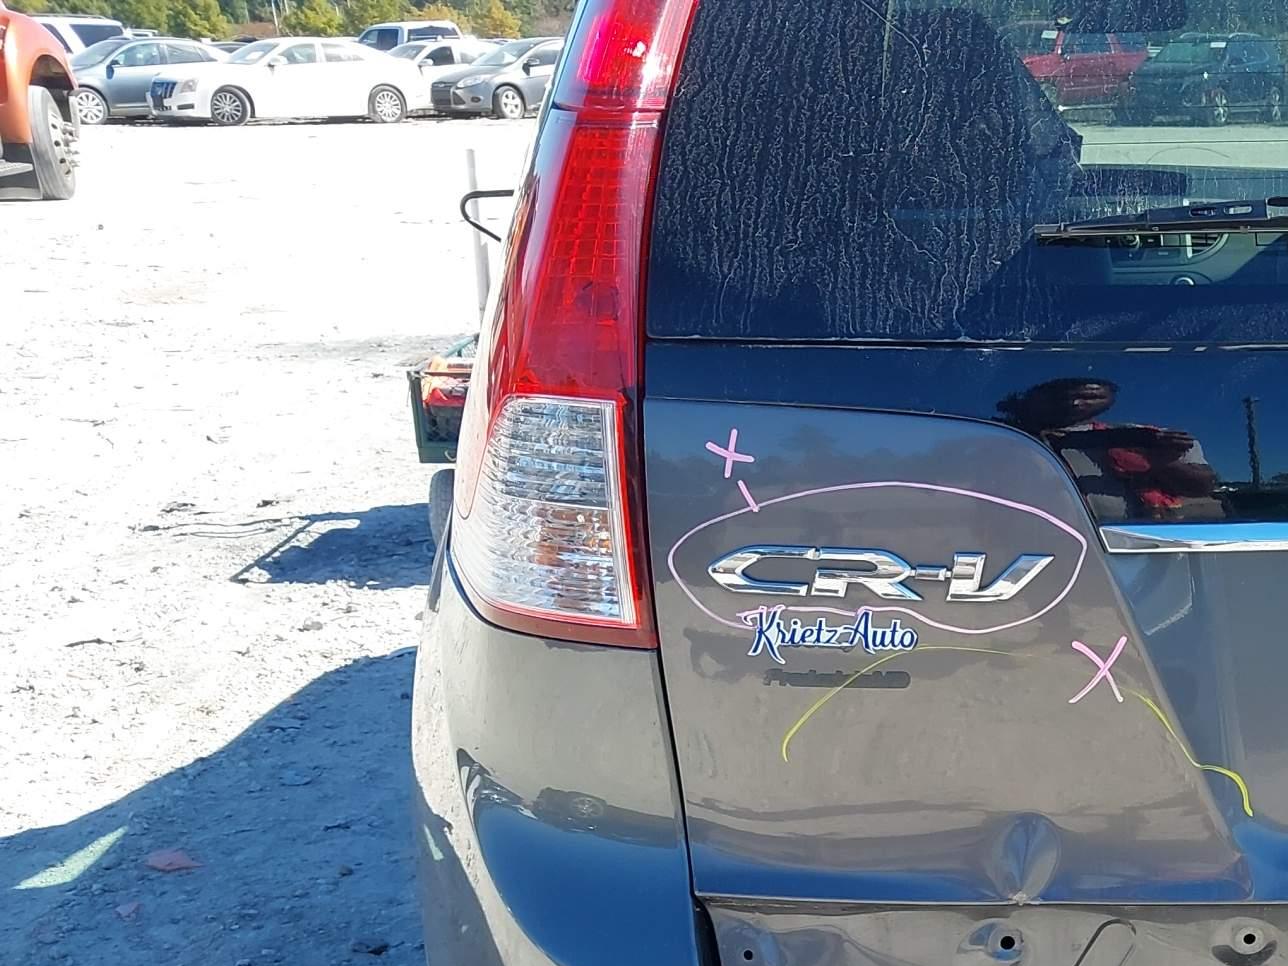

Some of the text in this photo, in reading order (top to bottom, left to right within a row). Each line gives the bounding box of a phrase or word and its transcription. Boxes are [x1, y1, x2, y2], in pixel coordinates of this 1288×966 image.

[708, 544, 1056, 601] CR-V
[743, 605, 918, 664] Krietz Auto
